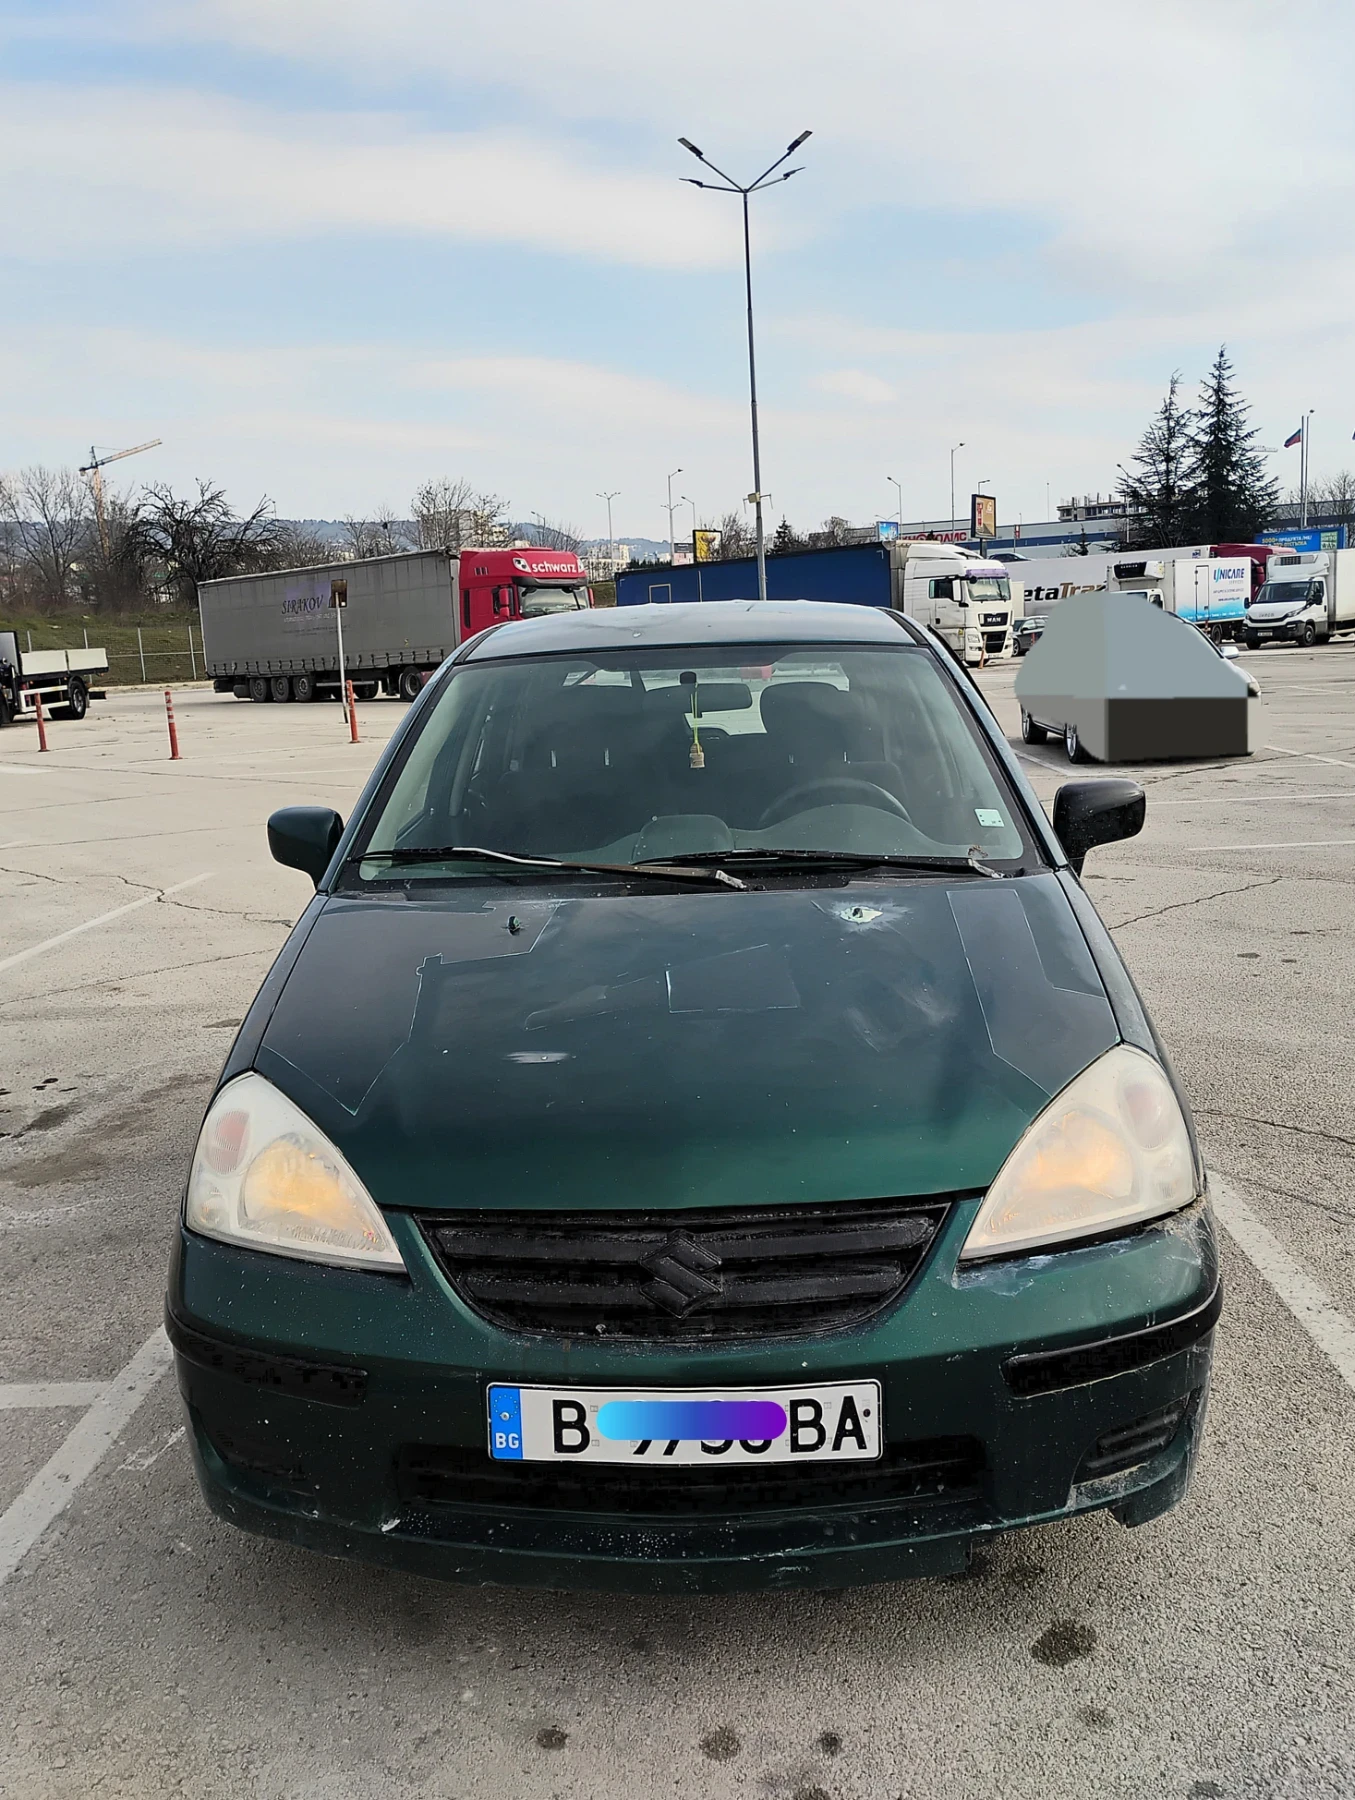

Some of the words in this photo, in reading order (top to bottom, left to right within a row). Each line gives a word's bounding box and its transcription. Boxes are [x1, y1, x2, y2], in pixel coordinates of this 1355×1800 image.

[531, 560, 577, 573] schwarz
[1213, 567, 1245, 583] UNICARE
[281, 594, 324, 615] SIRAKOV
[788, 1395, 868, 1454] BA
[494, 1432, 520, 1449] BG
